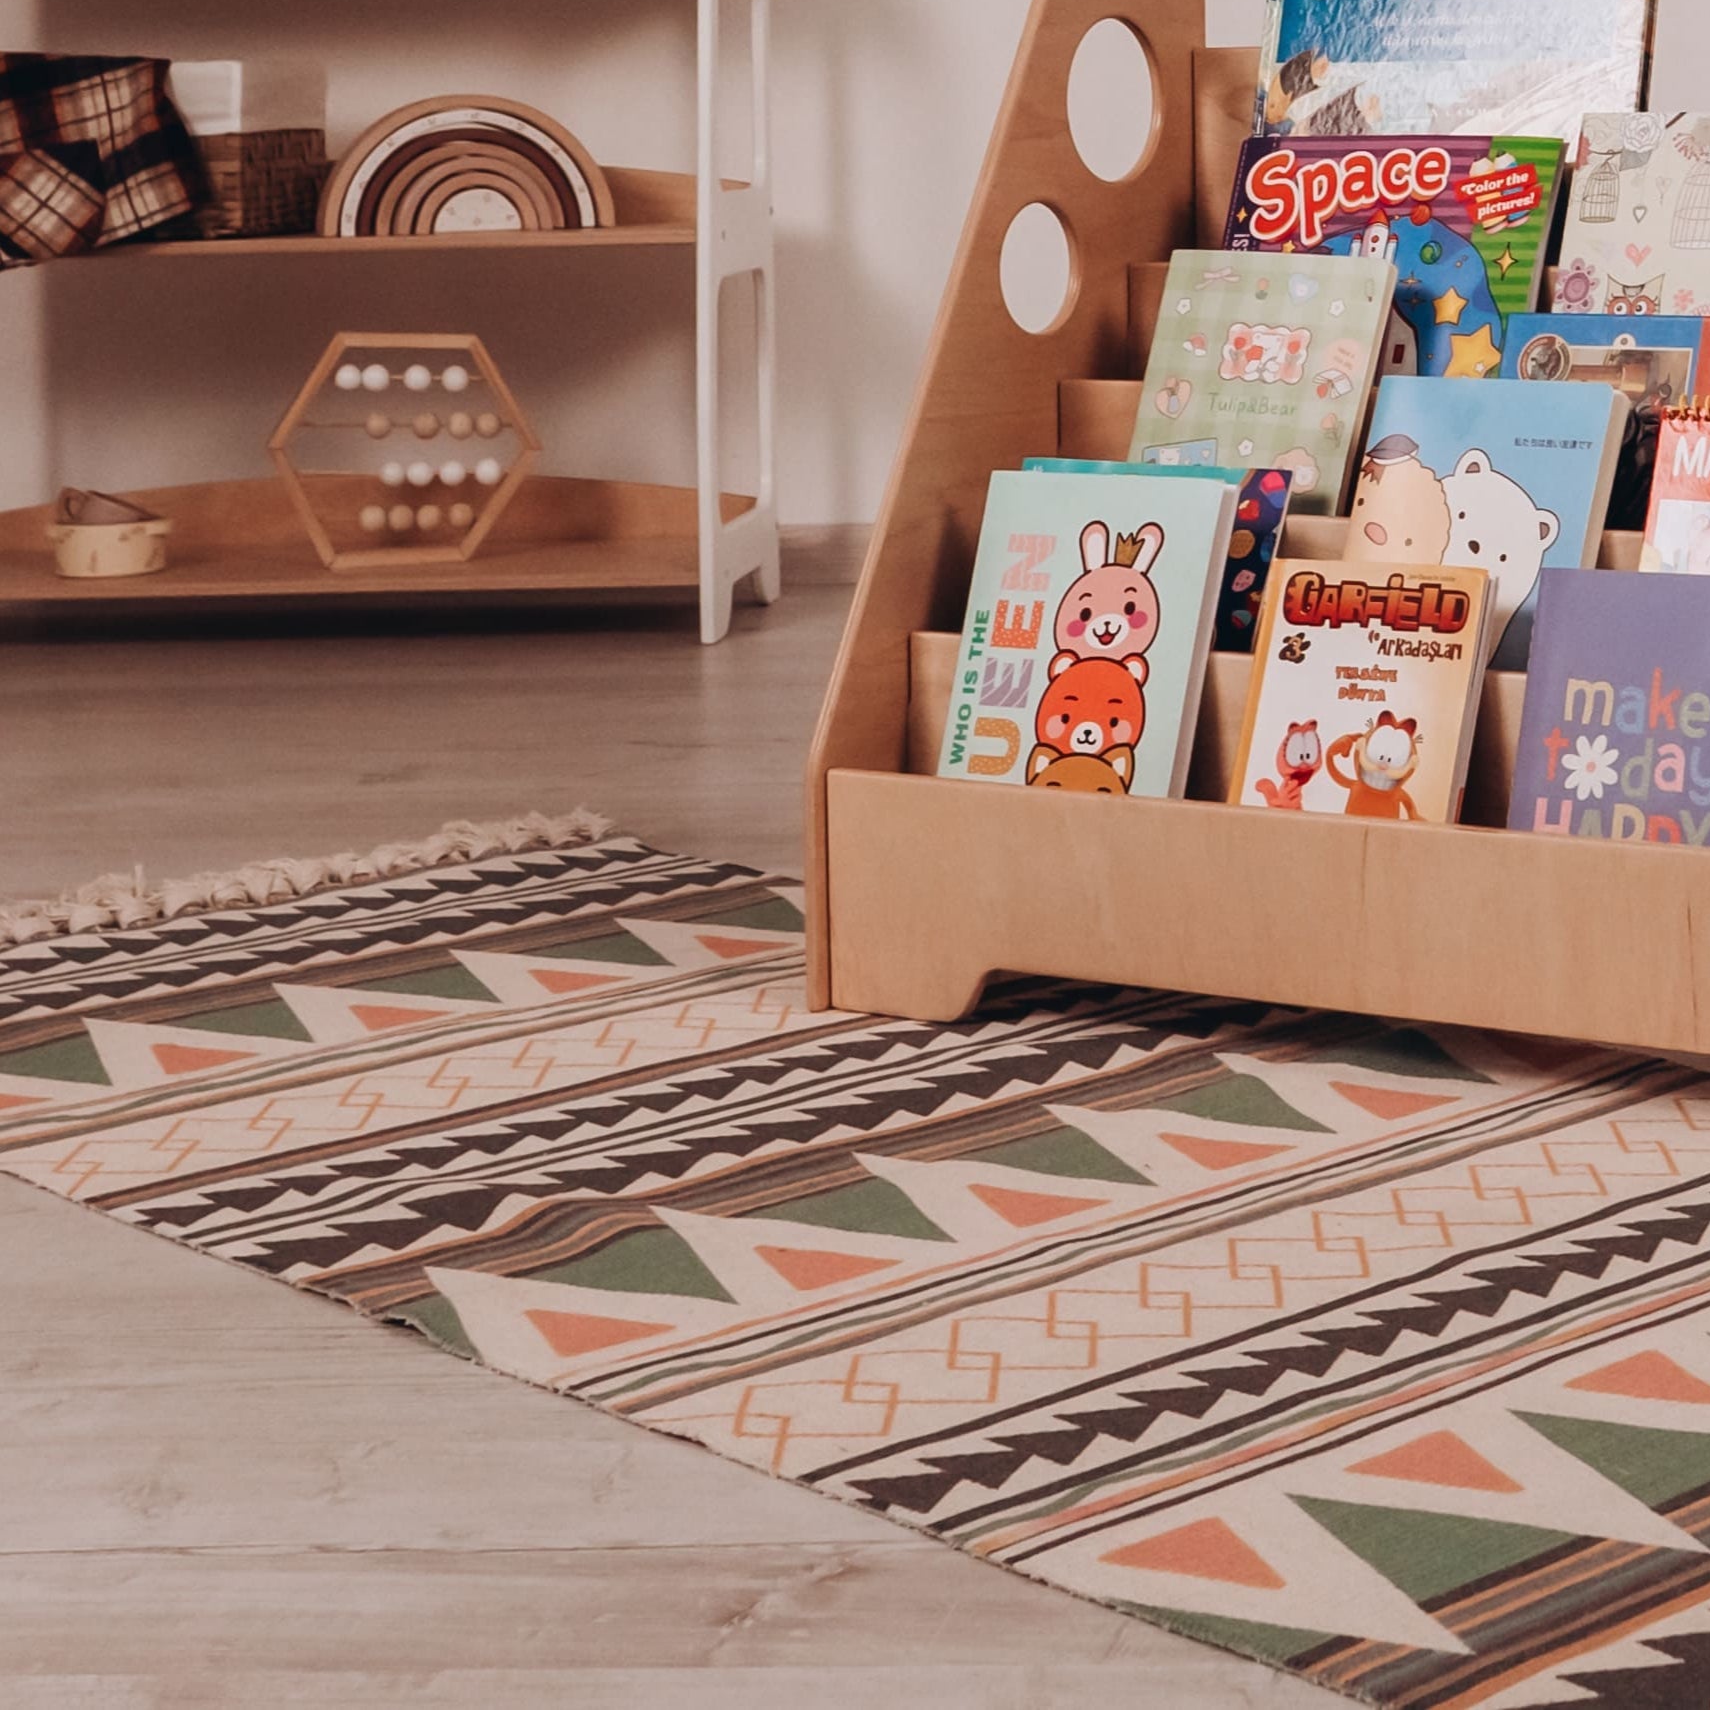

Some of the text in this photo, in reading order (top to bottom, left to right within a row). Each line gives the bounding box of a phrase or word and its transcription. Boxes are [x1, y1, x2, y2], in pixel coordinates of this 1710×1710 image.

[1246, 146, 1452, 247] Space
[1460, 172, 1529, 196] Color the
[1477, 191, 1536, 221] pictures!
[949, 608, 991, 765] WHO IS THE
[966, 533, 1058, 776] UEEN
